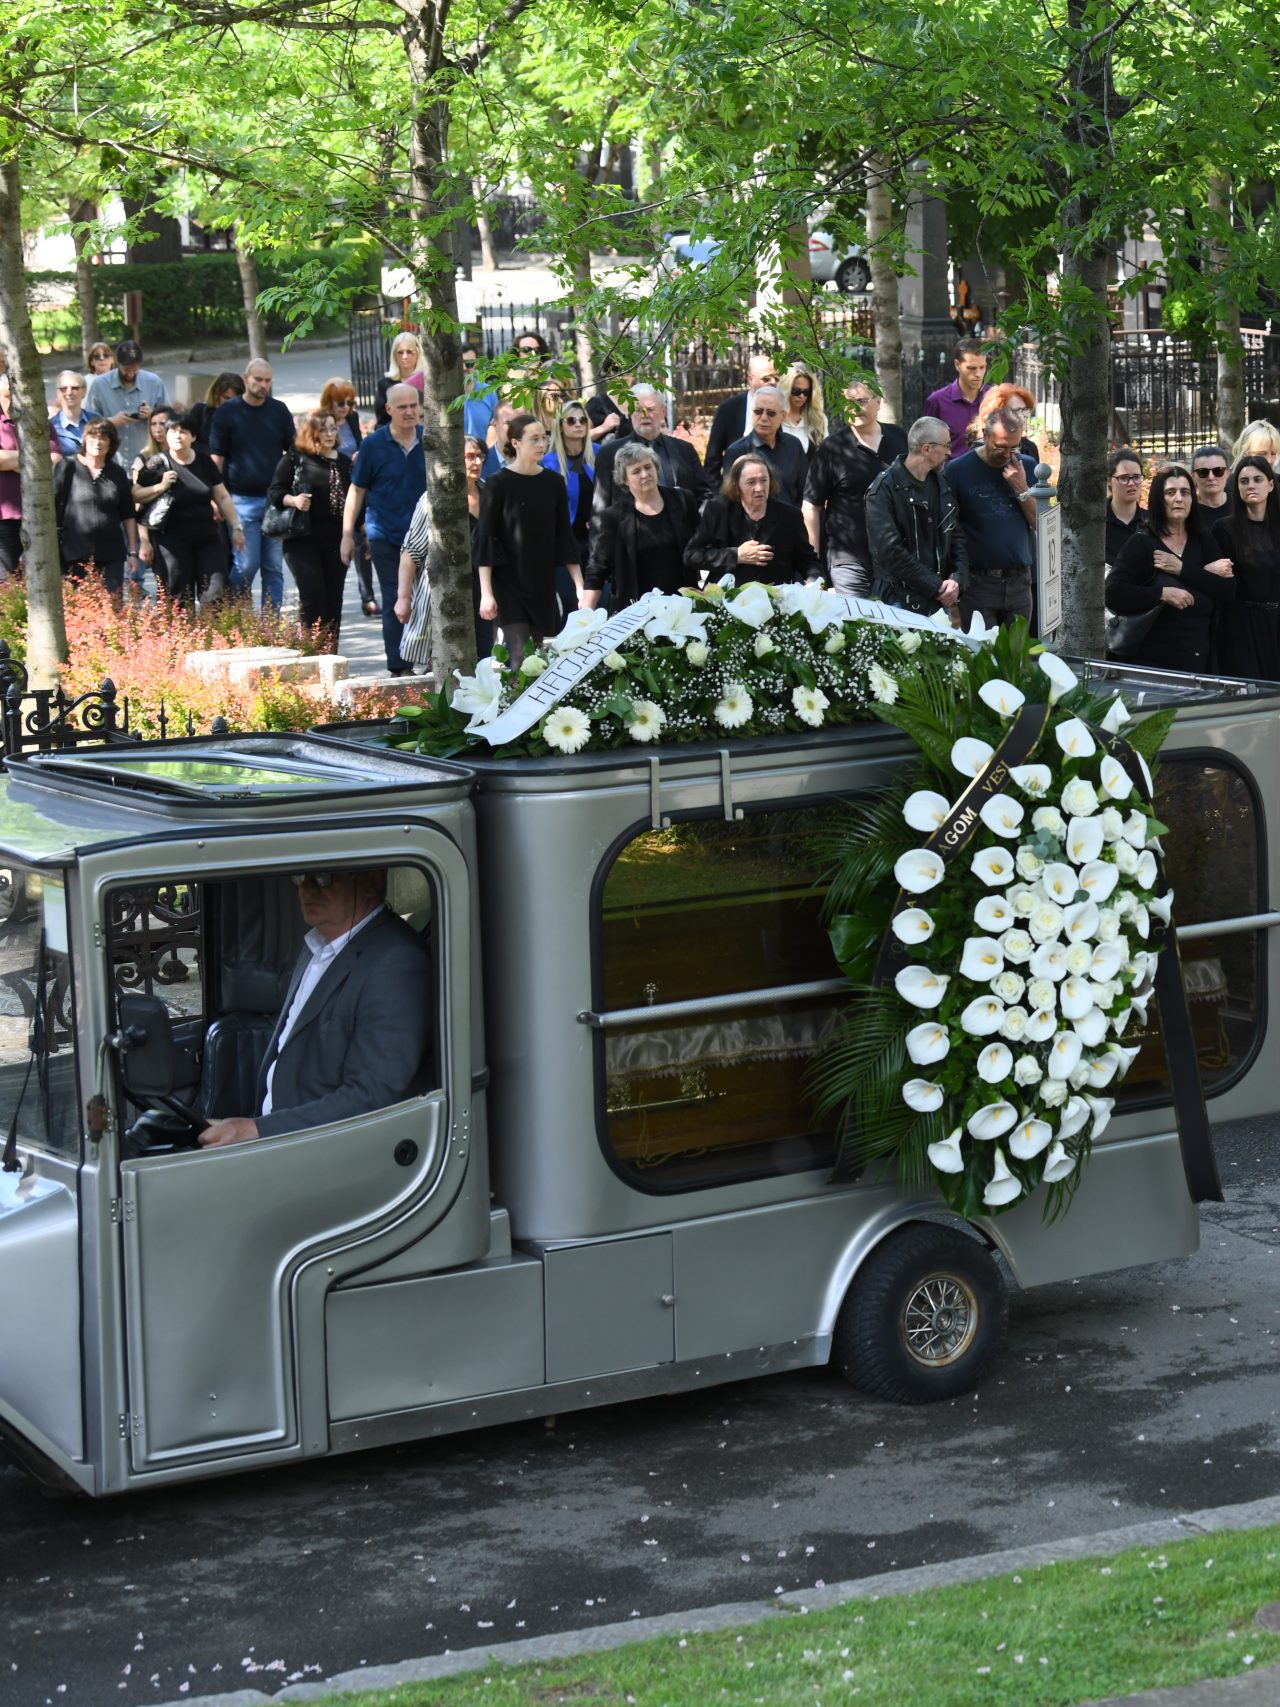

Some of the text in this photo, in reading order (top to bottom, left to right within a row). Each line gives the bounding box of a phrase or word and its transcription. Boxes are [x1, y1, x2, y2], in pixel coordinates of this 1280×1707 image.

[1048, 537, 1057, 577] 12
[527, 600, 651, 705] НАЈДРАЖЕ
[939, 805, 978, 856] AGOM
